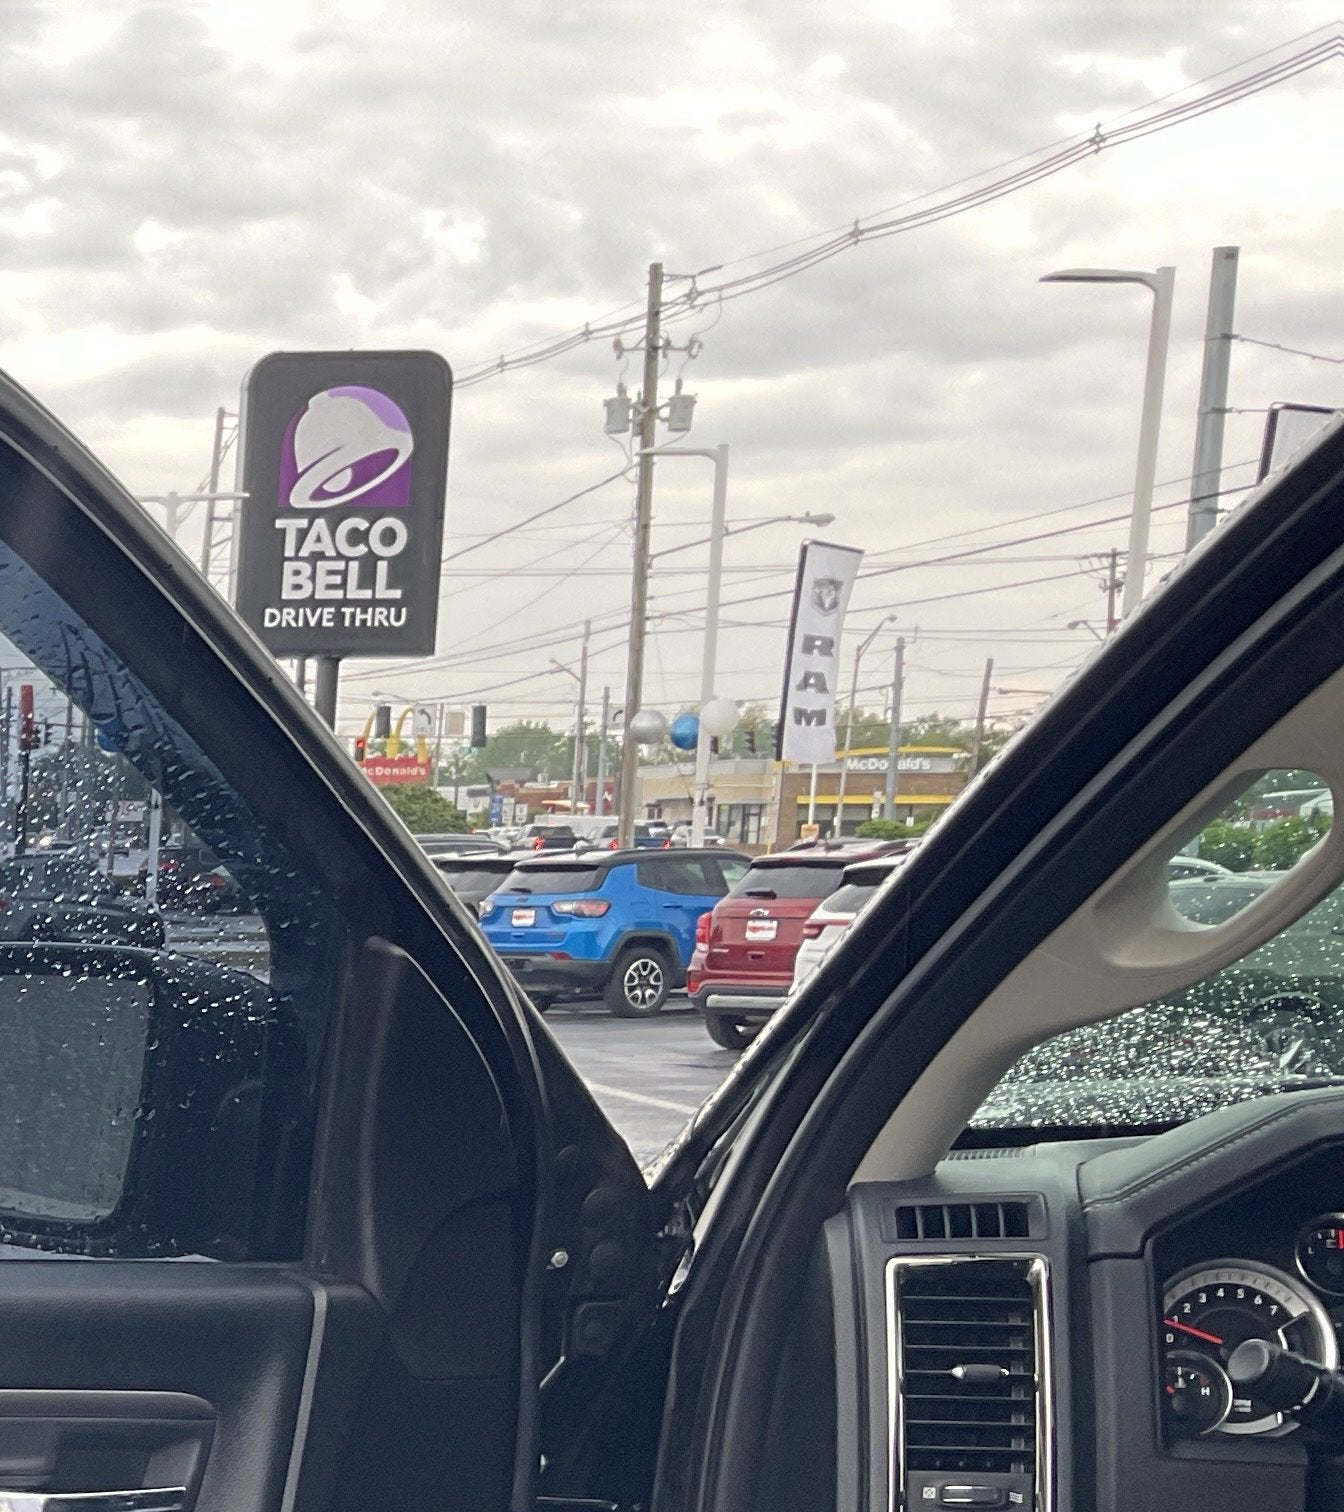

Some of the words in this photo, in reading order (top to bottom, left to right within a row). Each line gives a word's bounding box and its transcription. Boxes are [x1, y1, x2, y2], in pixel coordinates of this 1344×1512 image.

[275, 517, 408, 557] TACO
[281, 560, 403, 600] BELL
[263, 607, 335, 628] DRIVE
[341, 607, 407, 628] THRU
[793, 633, 834, 727] RAM
[846, 757, 931, 771] McDoald's
[1183, 1303, 1191, 1313] 2
[1199, 1293, 1207, 1303] 3
[1216, 1288, 1225, 1297] 4
[1237, 1288, 1245, 1298] 5
[1254, 1295, 1262, 1305] 6
[1270, 1305, 1278, 1315] 7
